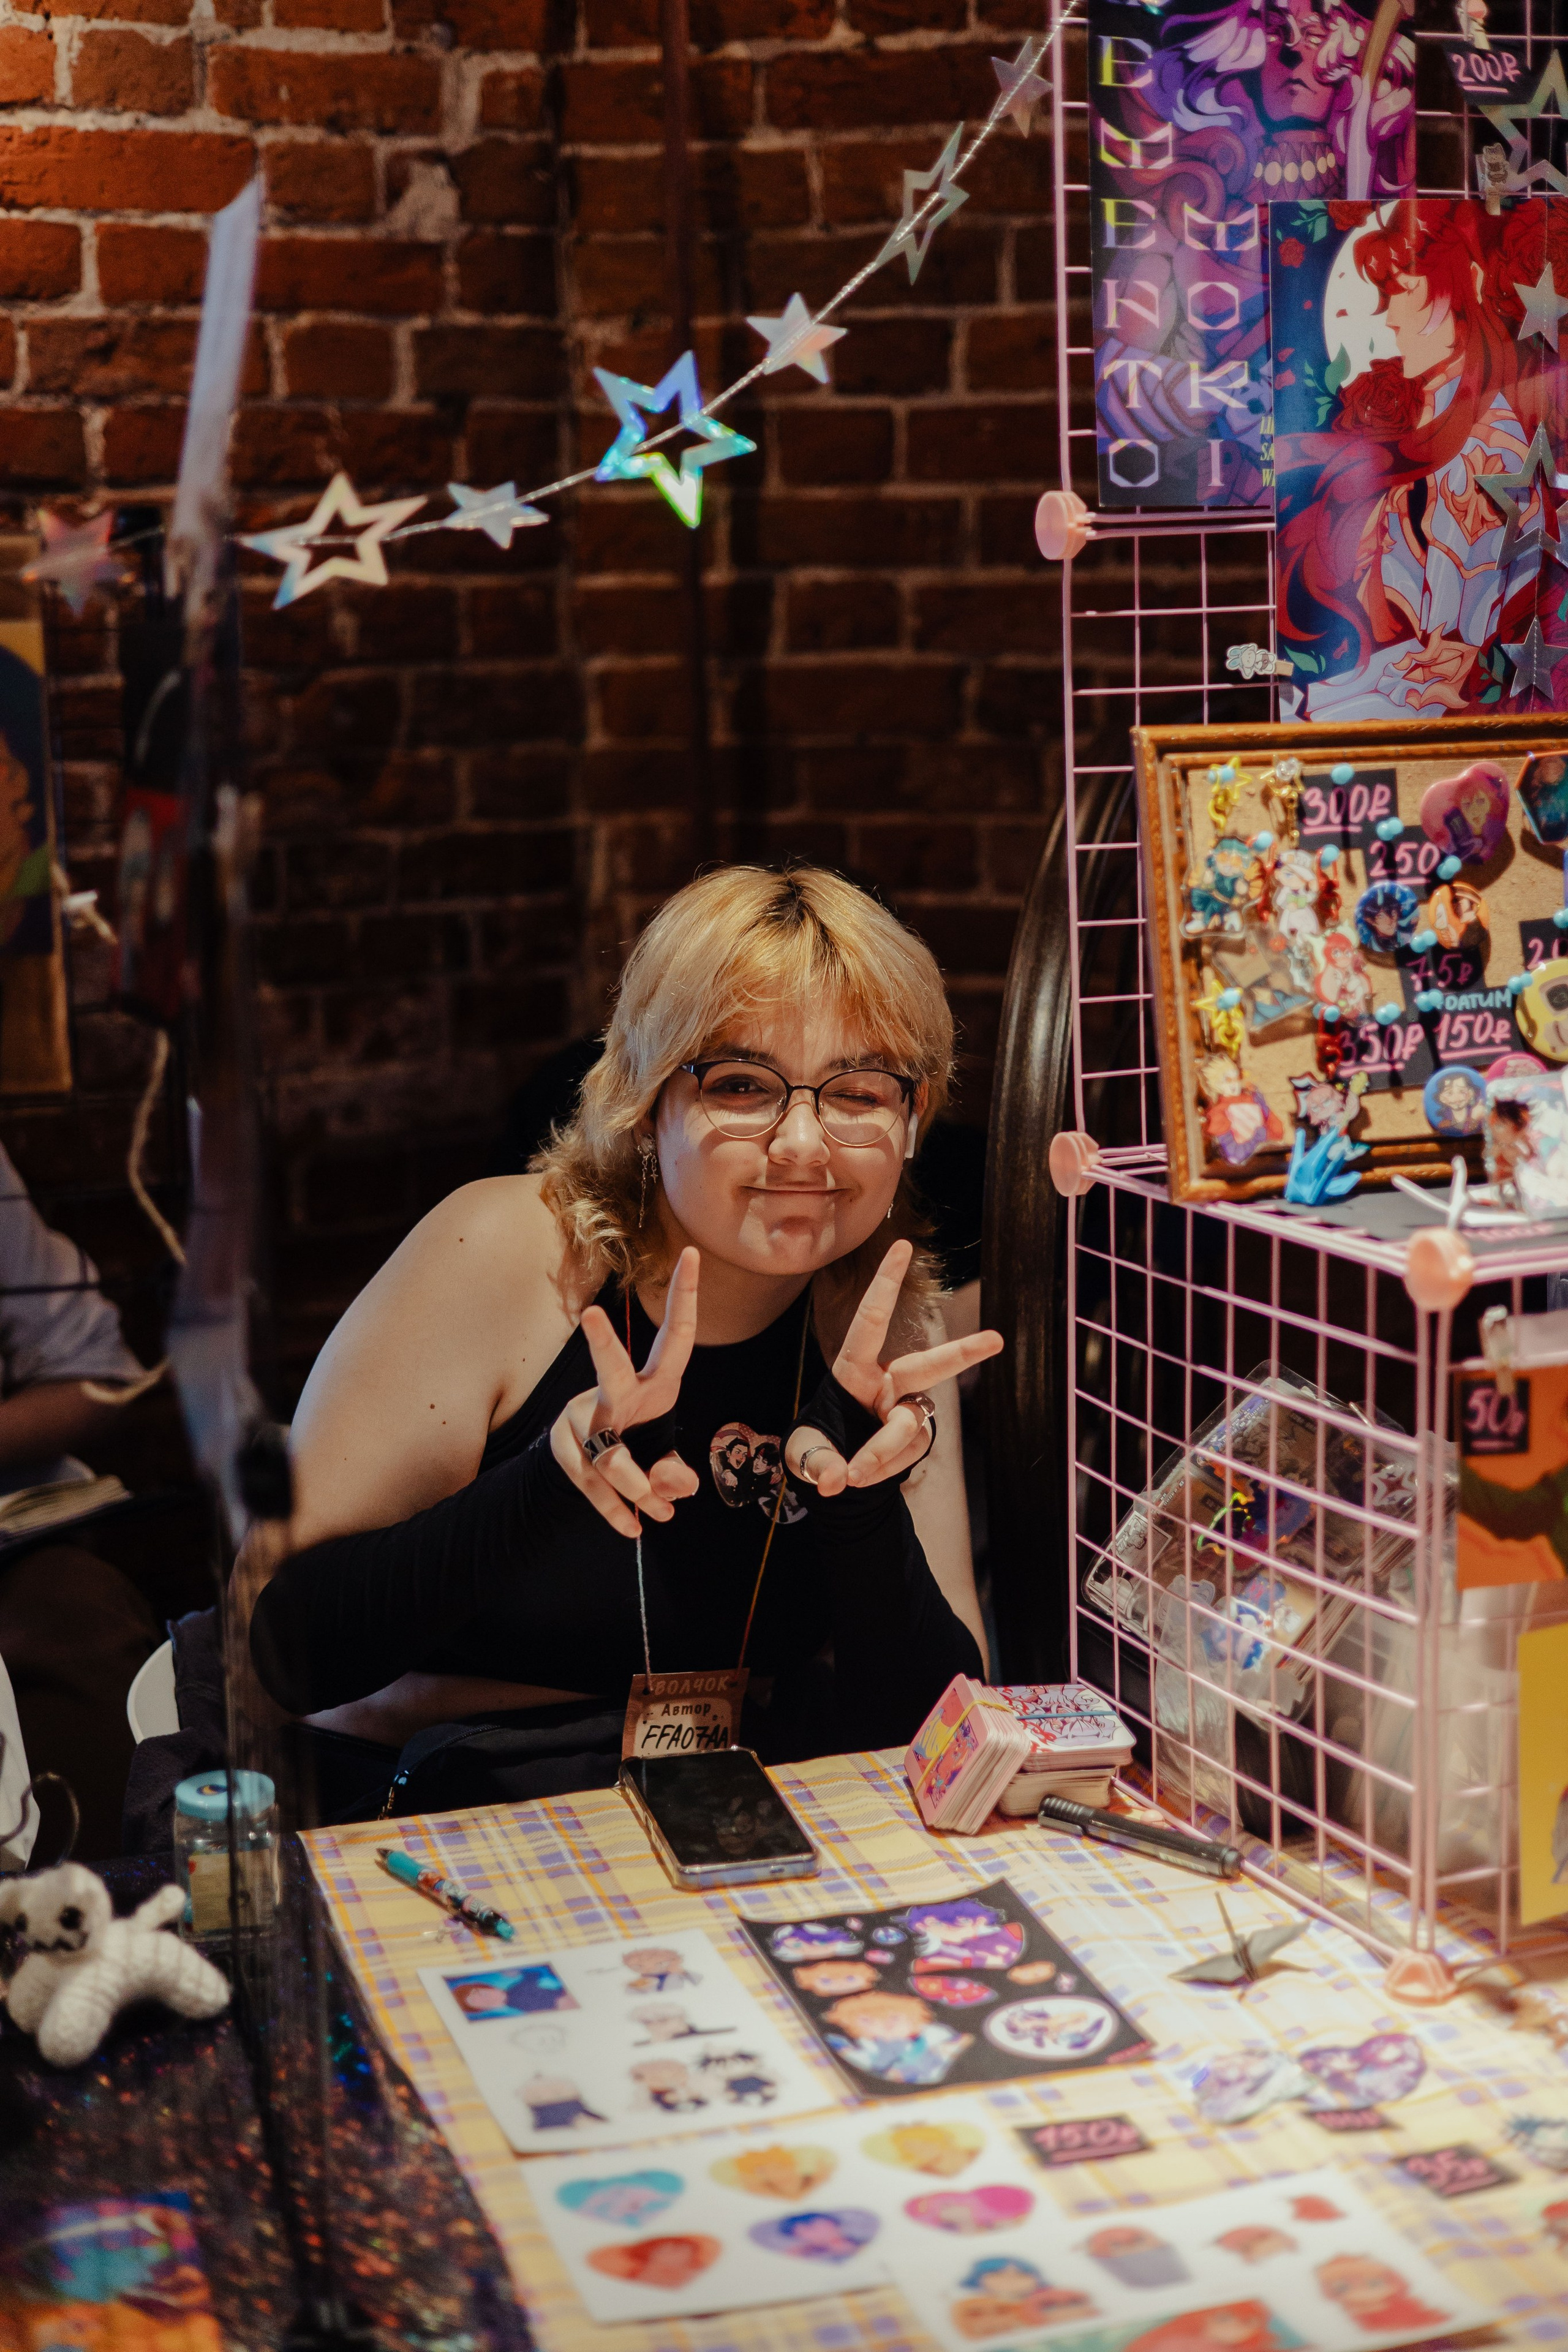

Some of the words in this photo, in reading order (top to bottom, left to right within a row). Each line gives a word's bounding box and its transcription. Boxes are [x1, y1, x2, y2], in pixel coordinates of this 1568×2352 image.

[1451, 51, 1522, 83] 200₽
[1303, 783, 1392, 826] 300₽
[1433, 1011, 1511, 1050] 150₽
[661, 1703, 712, 1717] Автор
